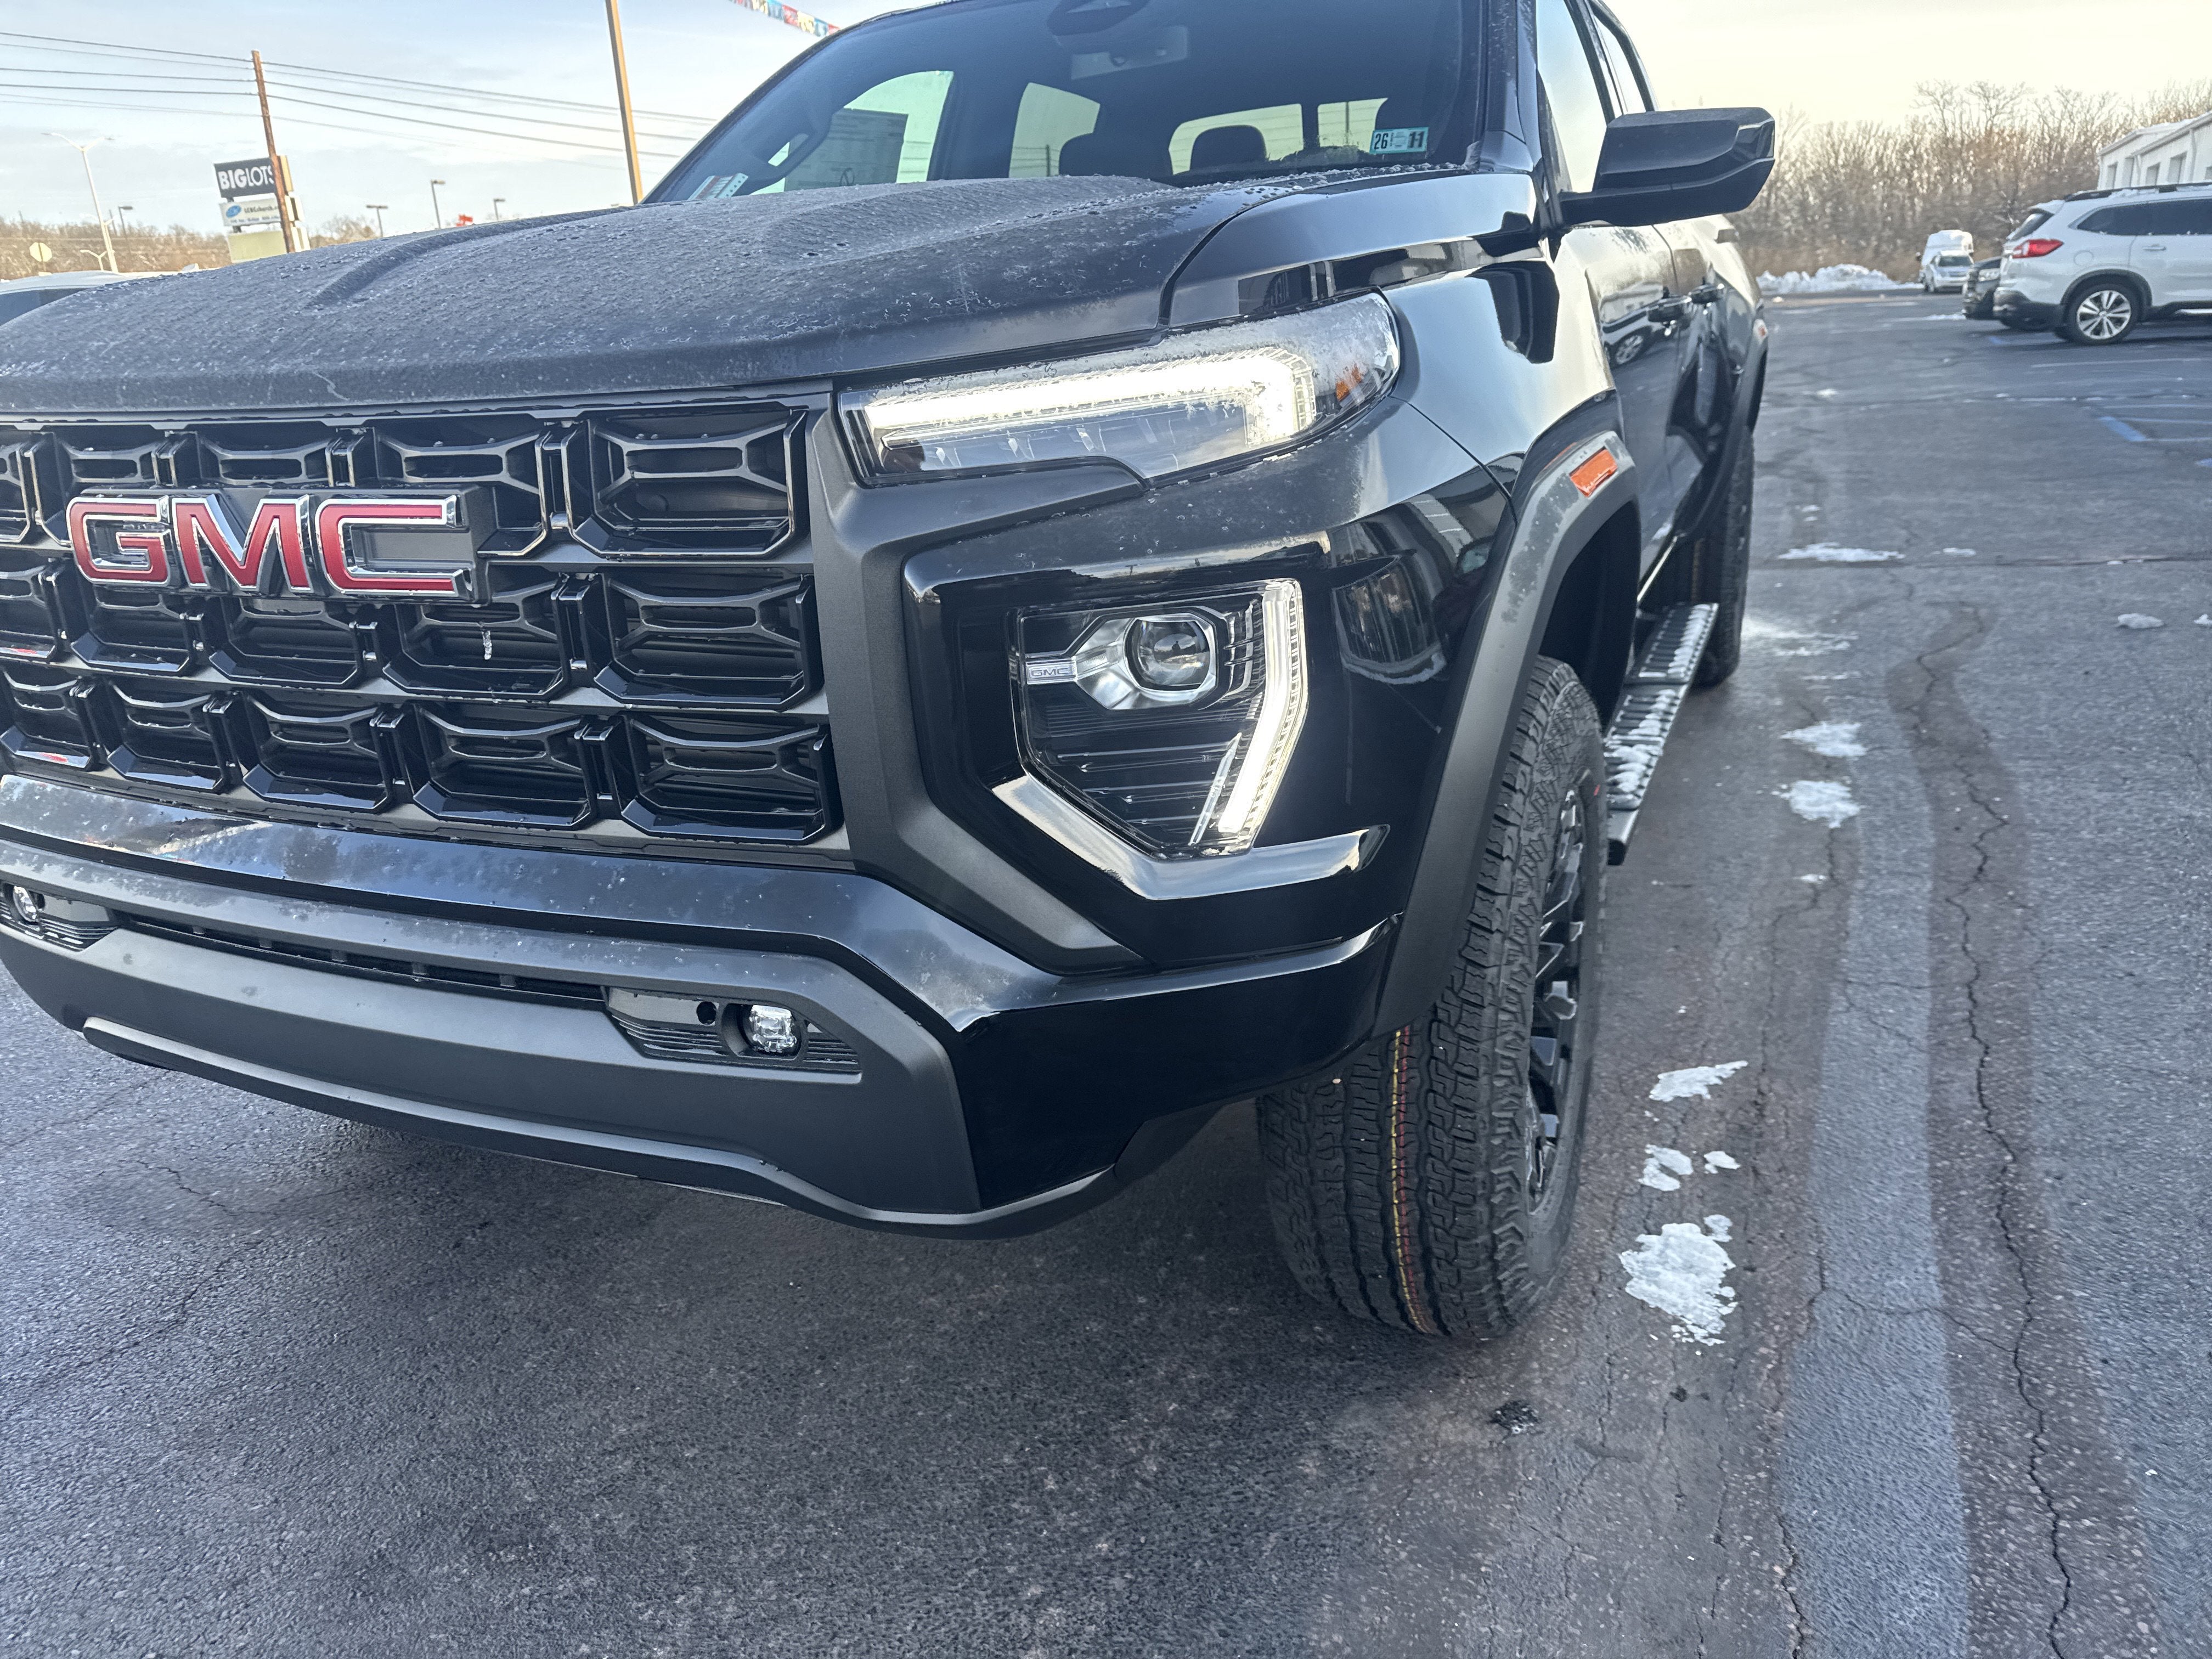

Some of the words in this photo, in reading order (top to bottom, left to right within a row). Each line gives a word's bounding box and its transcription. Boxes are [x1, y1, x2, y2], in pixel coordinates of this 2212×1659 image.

[1374, 133, 1389, 149] 26
[66, 494, 473, 595] GMC
[1031, 668, 1069, 676] GMC
